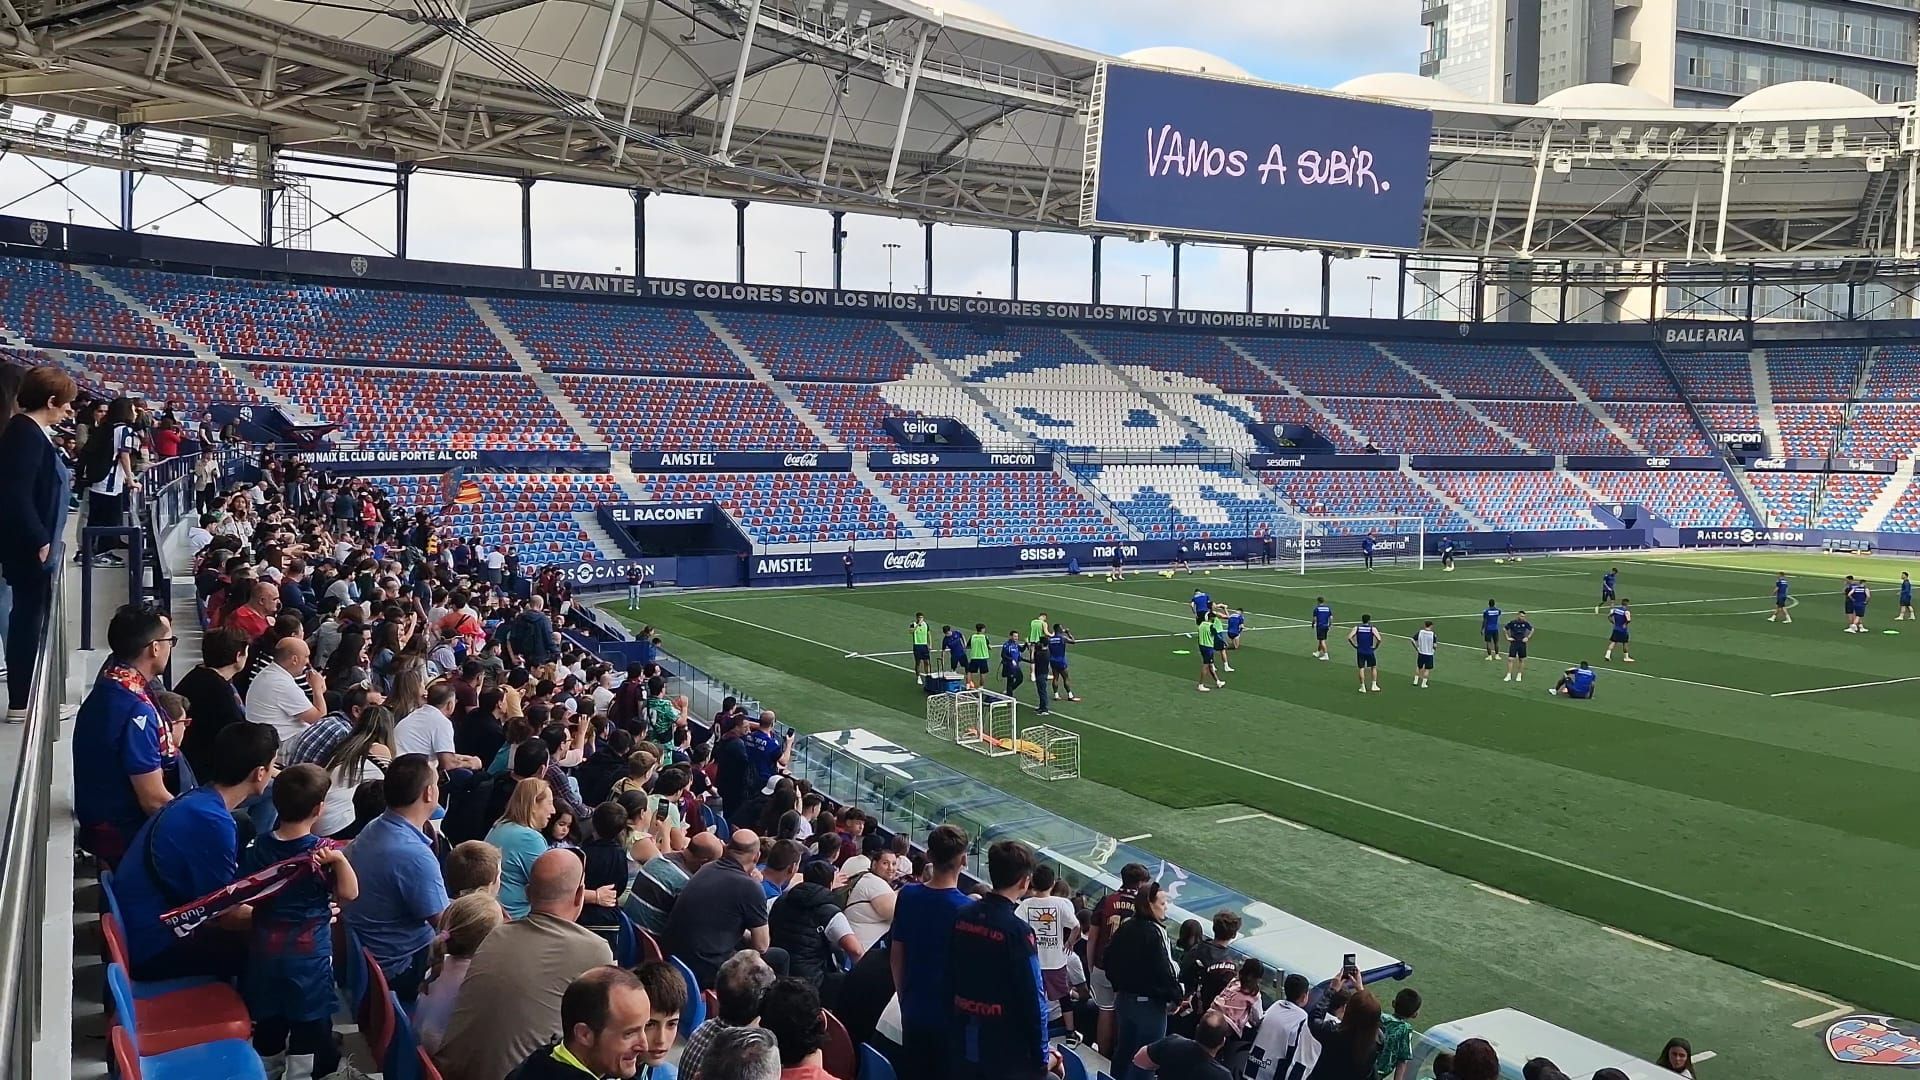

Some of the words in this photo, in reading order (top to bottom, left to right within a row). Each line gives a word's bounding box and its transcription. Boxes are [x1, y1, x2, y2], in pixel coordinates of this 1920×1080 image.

[1147, 124, 1248, 178] VAMOS
[1257, 143, 1287, 185] A
[539, 272, 643, 297] LEVANTE,
[648, 279, 687, 297] TUS
[692, 283, 783, 302] COLORES
[788, 288, 828, 306] SON
[834, 291, 869, 308] LOS
[927, 297, 960, 312] TUS
[965, 299, 1042, 317] COLORES
[1046, 303, 1081, 319] SON
[1084, 305, 1115, 320] LOS
[1119, 305, 1158, 323] MÍOS
[1161, 309, 1172, 323] Y
[1177, 310, 1197, 325] TU
[1201, 312, 1264, 328] NOMBRE
[1267, 314, 1285, 328] MI
[1288, 315, 1331, 330] IDEAL
[1665, 327, 1745, 343] BALEARIA
[902, 419, 938, 434] teika
[316, 452, 338, 463] NAIX
[339, 452, 350, 462] EL
[351, 451, 375, 462] CLUB
[377, 451, 399, 462] QUE
[400, 450, 435, 461] PORTE
[438, 450, 453, 461] AL
[455, 450, 478, 460] COR
[660, 453, 715, 466] AMSTEL
[990, 453, 1035, 465] macron
[1266, 457, 1302, 467] sesderma
[612, 509, 631, 521] EL
[634, 508, 704, 521] RACONET
[1193, 541, 1232, 551] MARCOS
[756, 557, 812, 574] AMSTEL
[180, 906, 206, 923] club
